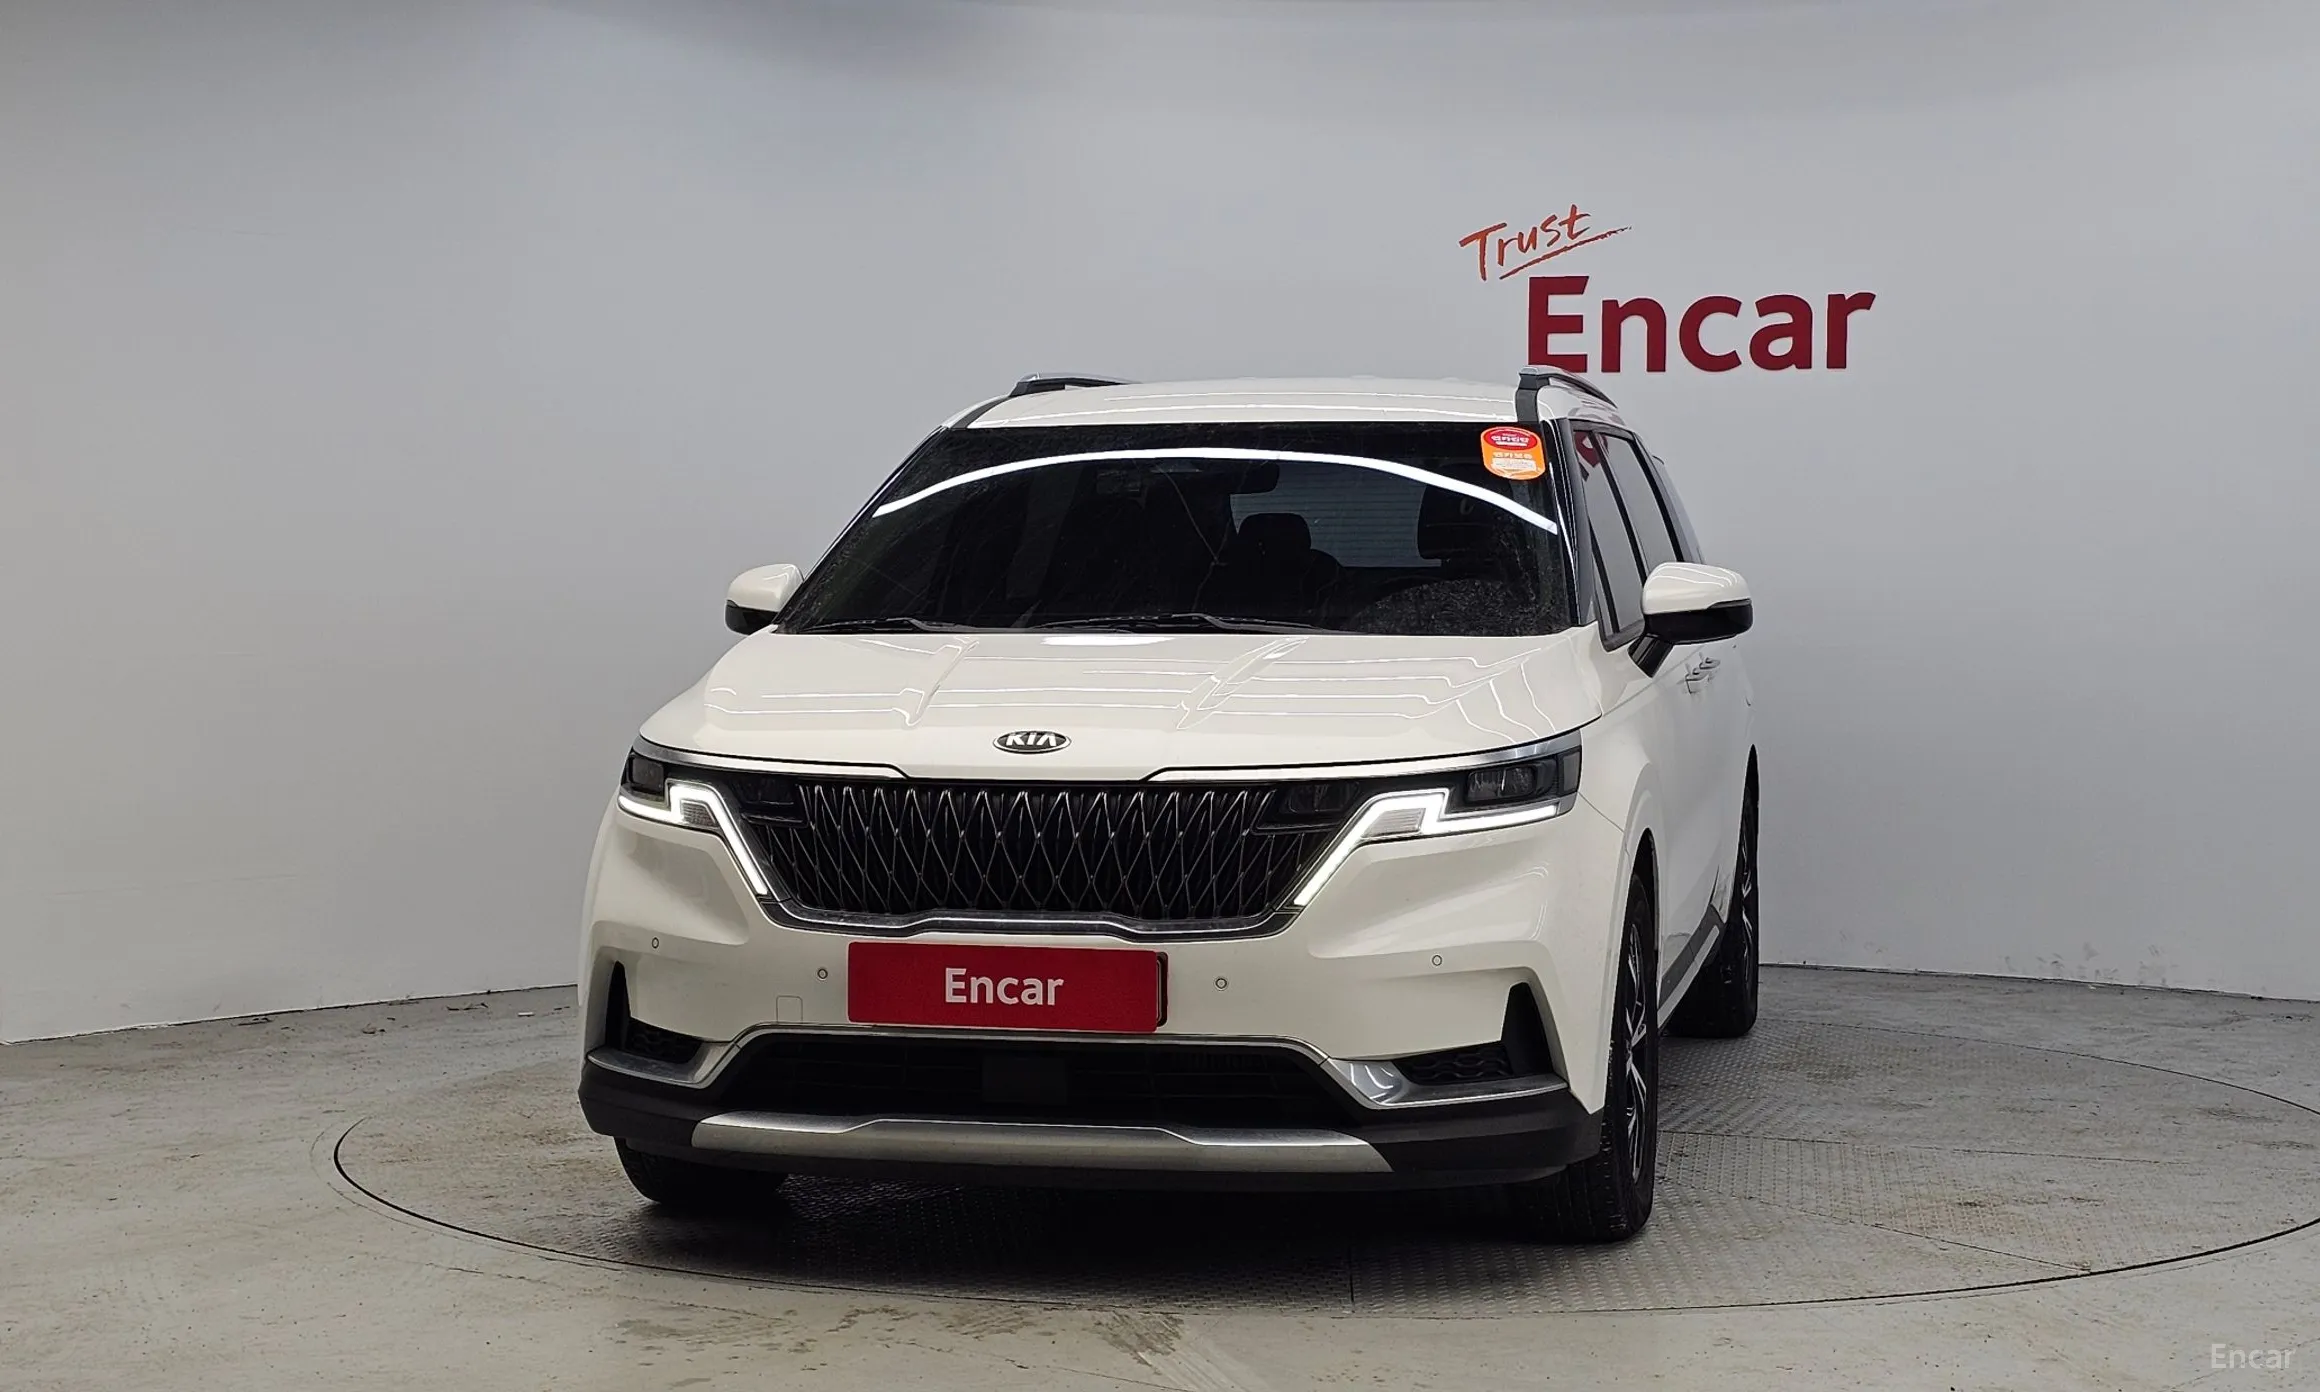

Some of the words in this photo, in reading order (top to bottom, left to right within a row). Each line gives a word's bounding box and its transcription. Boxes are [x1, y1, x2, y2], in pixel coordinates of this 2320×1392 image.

[1459, 204, 1591, 281] Trust
[1528, 276, 1877, 373] Encar
[1006, 732, 1057, 746] KIA
[945, 968, 1064, 1006] Encar
